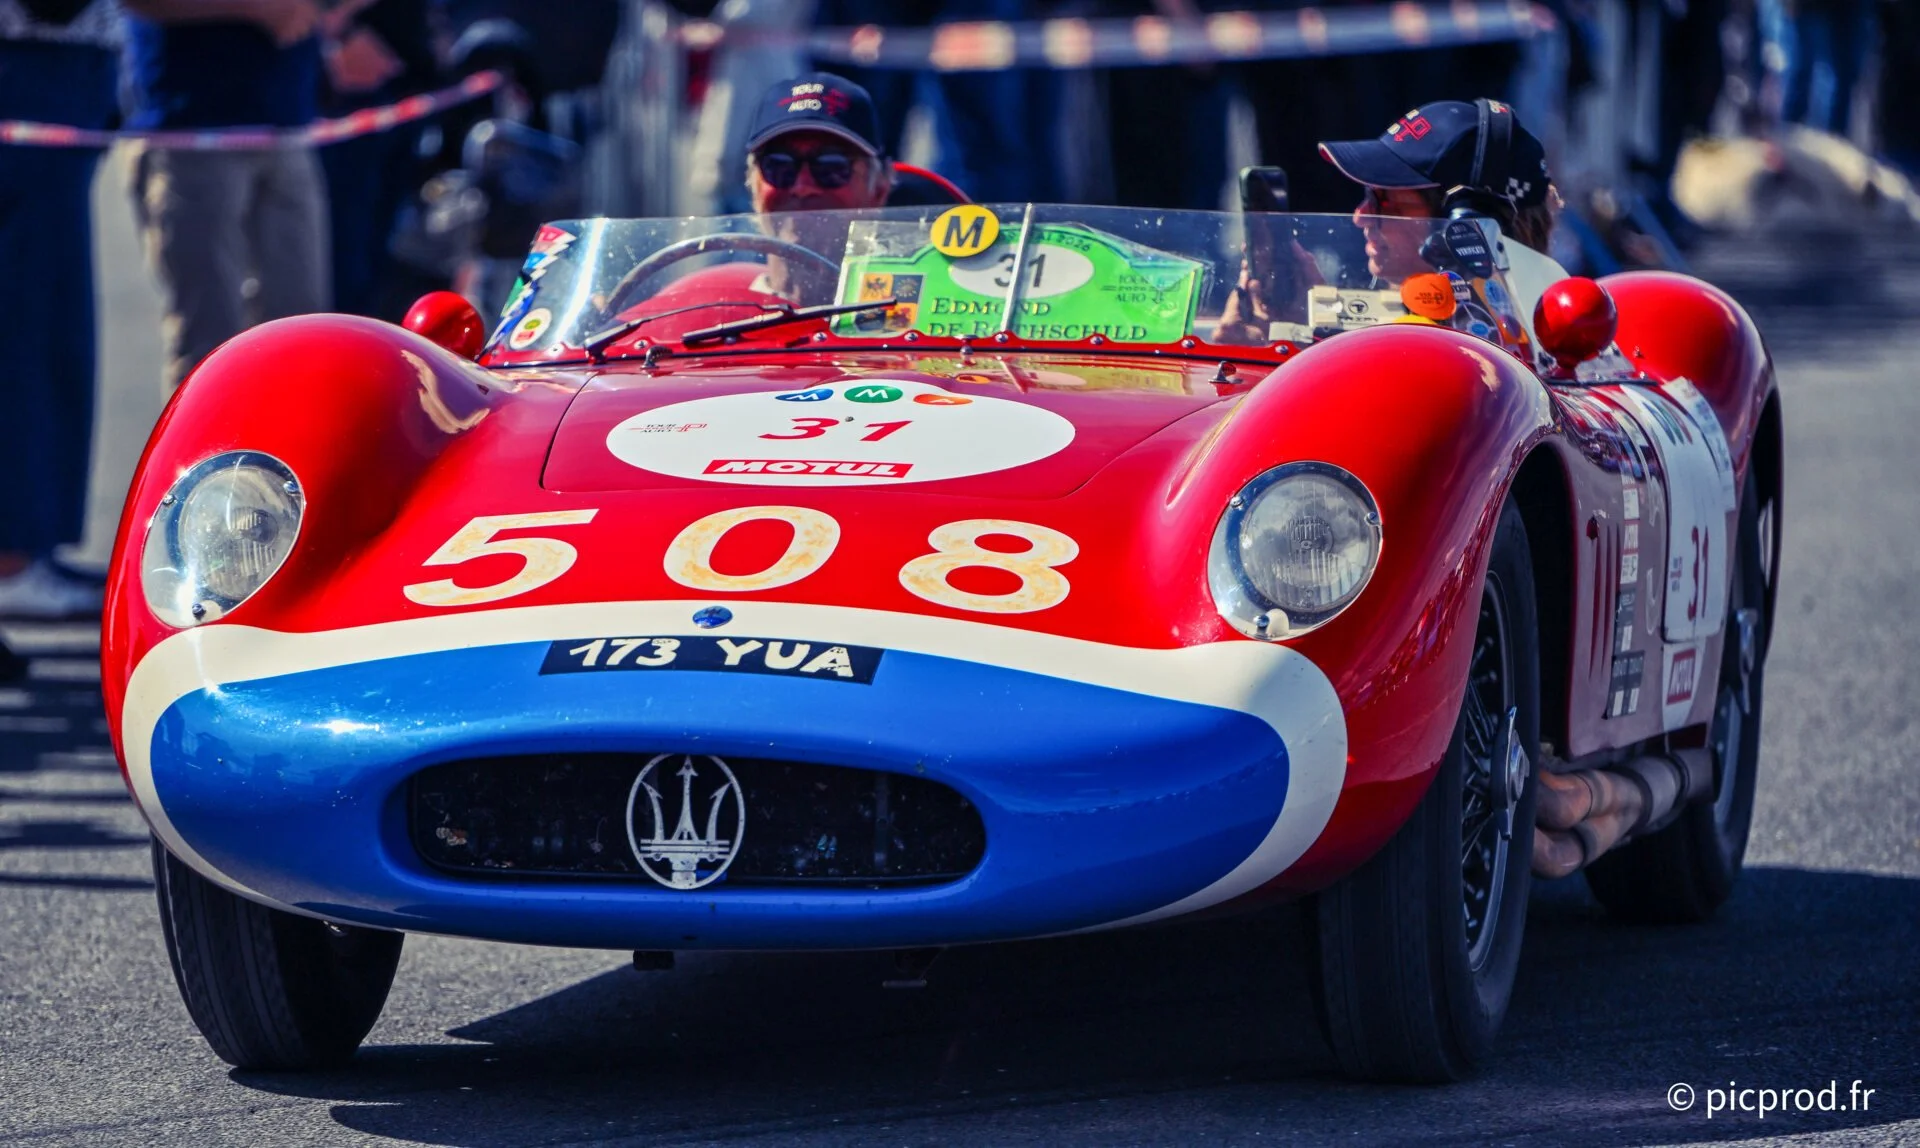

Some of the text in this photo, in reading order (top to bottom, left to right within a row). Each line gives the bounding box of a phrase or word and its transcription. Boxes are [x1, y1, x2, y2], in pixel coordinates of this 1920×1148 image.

[788, 98, 822, 112] AUTO
[942, 215, 986, 248] M
[993, 253, 1047, 288] 31
[928, 322, 963, 337] DE
[855, 388, 889, 400] M
[713, 460, 899, 477] MOTUL
[402, 504, 1080, 614] 508
[1687, 526, 1709, 622] 31
[568, 637, 855, 678] 173 YUA
